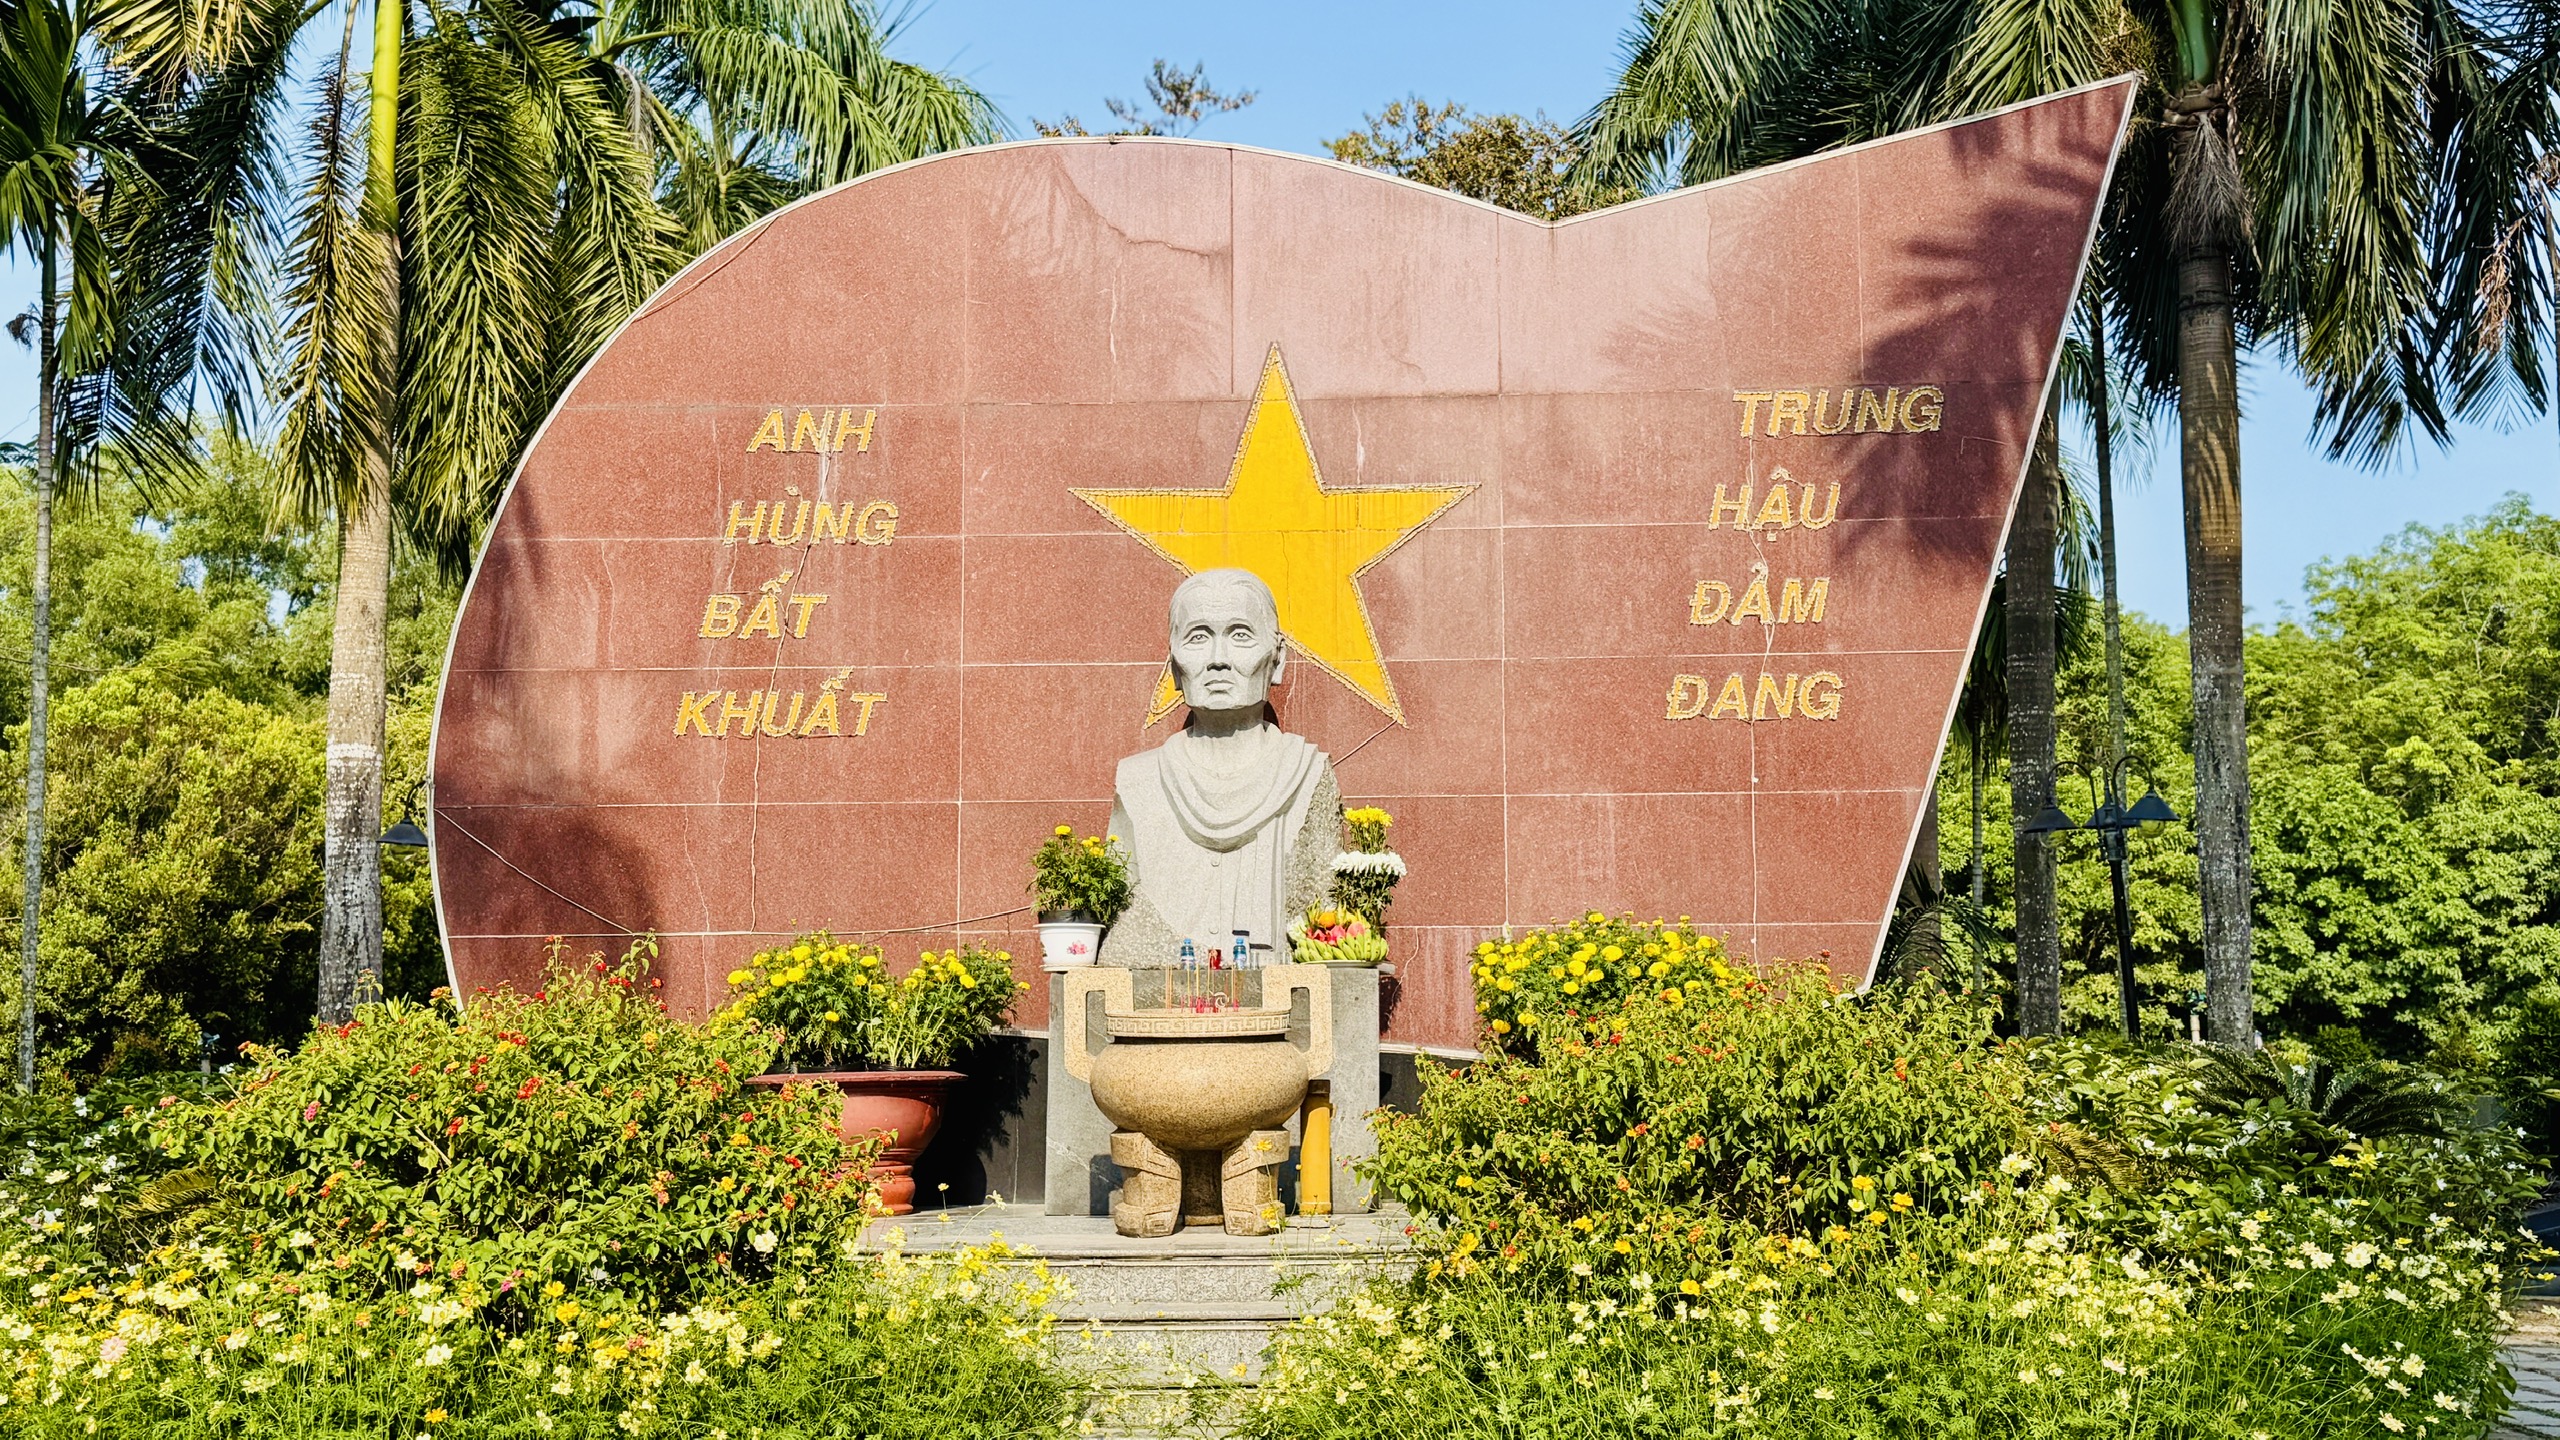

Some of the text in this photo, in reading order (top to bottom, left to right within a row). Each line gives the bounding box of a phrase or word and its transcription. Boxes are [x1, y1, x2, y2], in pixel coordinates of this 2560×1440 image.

[747, 408, 877, 452] ANH
[1733, 386, 1944, 438] TRUNG
[723, 484, 899, 547] HÙNG
[1708, 466, 1840, 542] HẬU
[699, 571, 829, 639] BẤT
[1689, 562, 1830, 625] ĐẢM
[674, 666, 888, 737] KHUẤT
[1665, 671, 1845, 720] ĐANG
